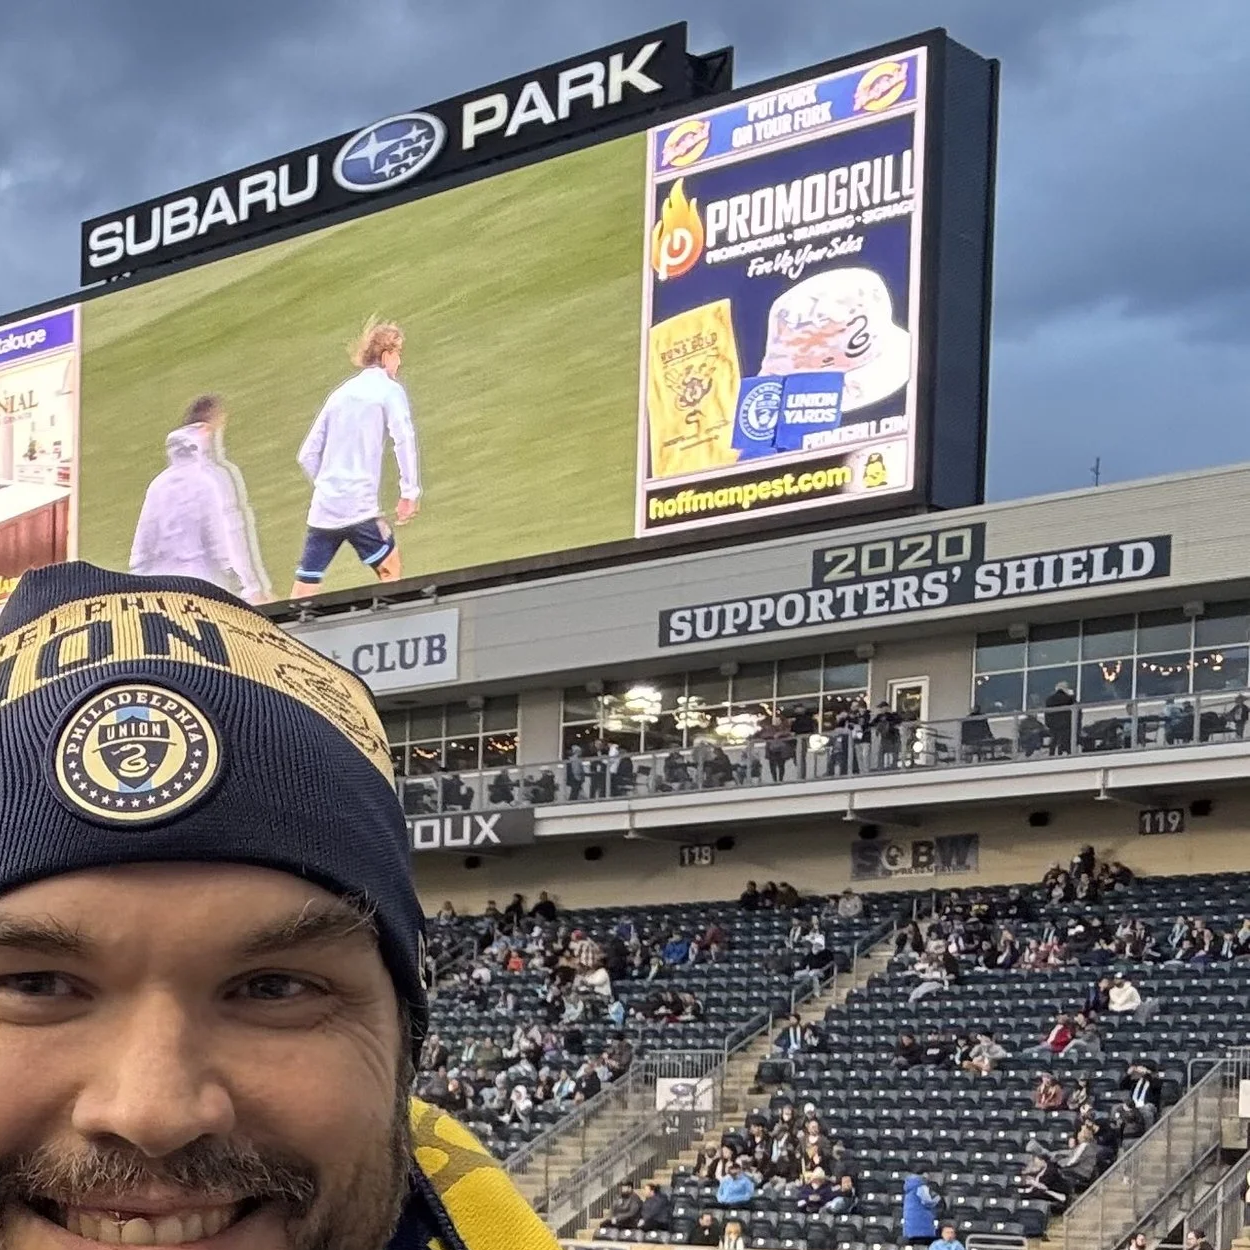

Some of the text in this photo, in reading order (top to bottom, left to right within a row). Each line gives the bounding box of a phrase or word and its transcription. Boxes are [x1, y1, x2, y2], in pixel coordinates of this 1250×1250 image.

[747, 96, 776, 122] PUT
[754, 113, 792, 141] YOUR
[793, 101, 833, 131] FORK
[88, 154, 319, 269] SUBARU
[461, 40, 663, 150] PARK
[705, 149, 915, 248] PROMOGRILL
[783, 408, 837, 425] YARDS
[785, 392, 839, 409] UNION
[649, 466, 852, 519] hoffmanpest.com
[823, 528, 973, 583] 2020
[974, 540, 1156, 600] SHIELD
[352, 633, 447, 676] CLUB
[66, 691, 204, 755] PHILADELPHIA
[106, 722, 162, 740] UNION
[406, 813, 501, 850] OUX
[1141, 811, 1181, 833] 119
